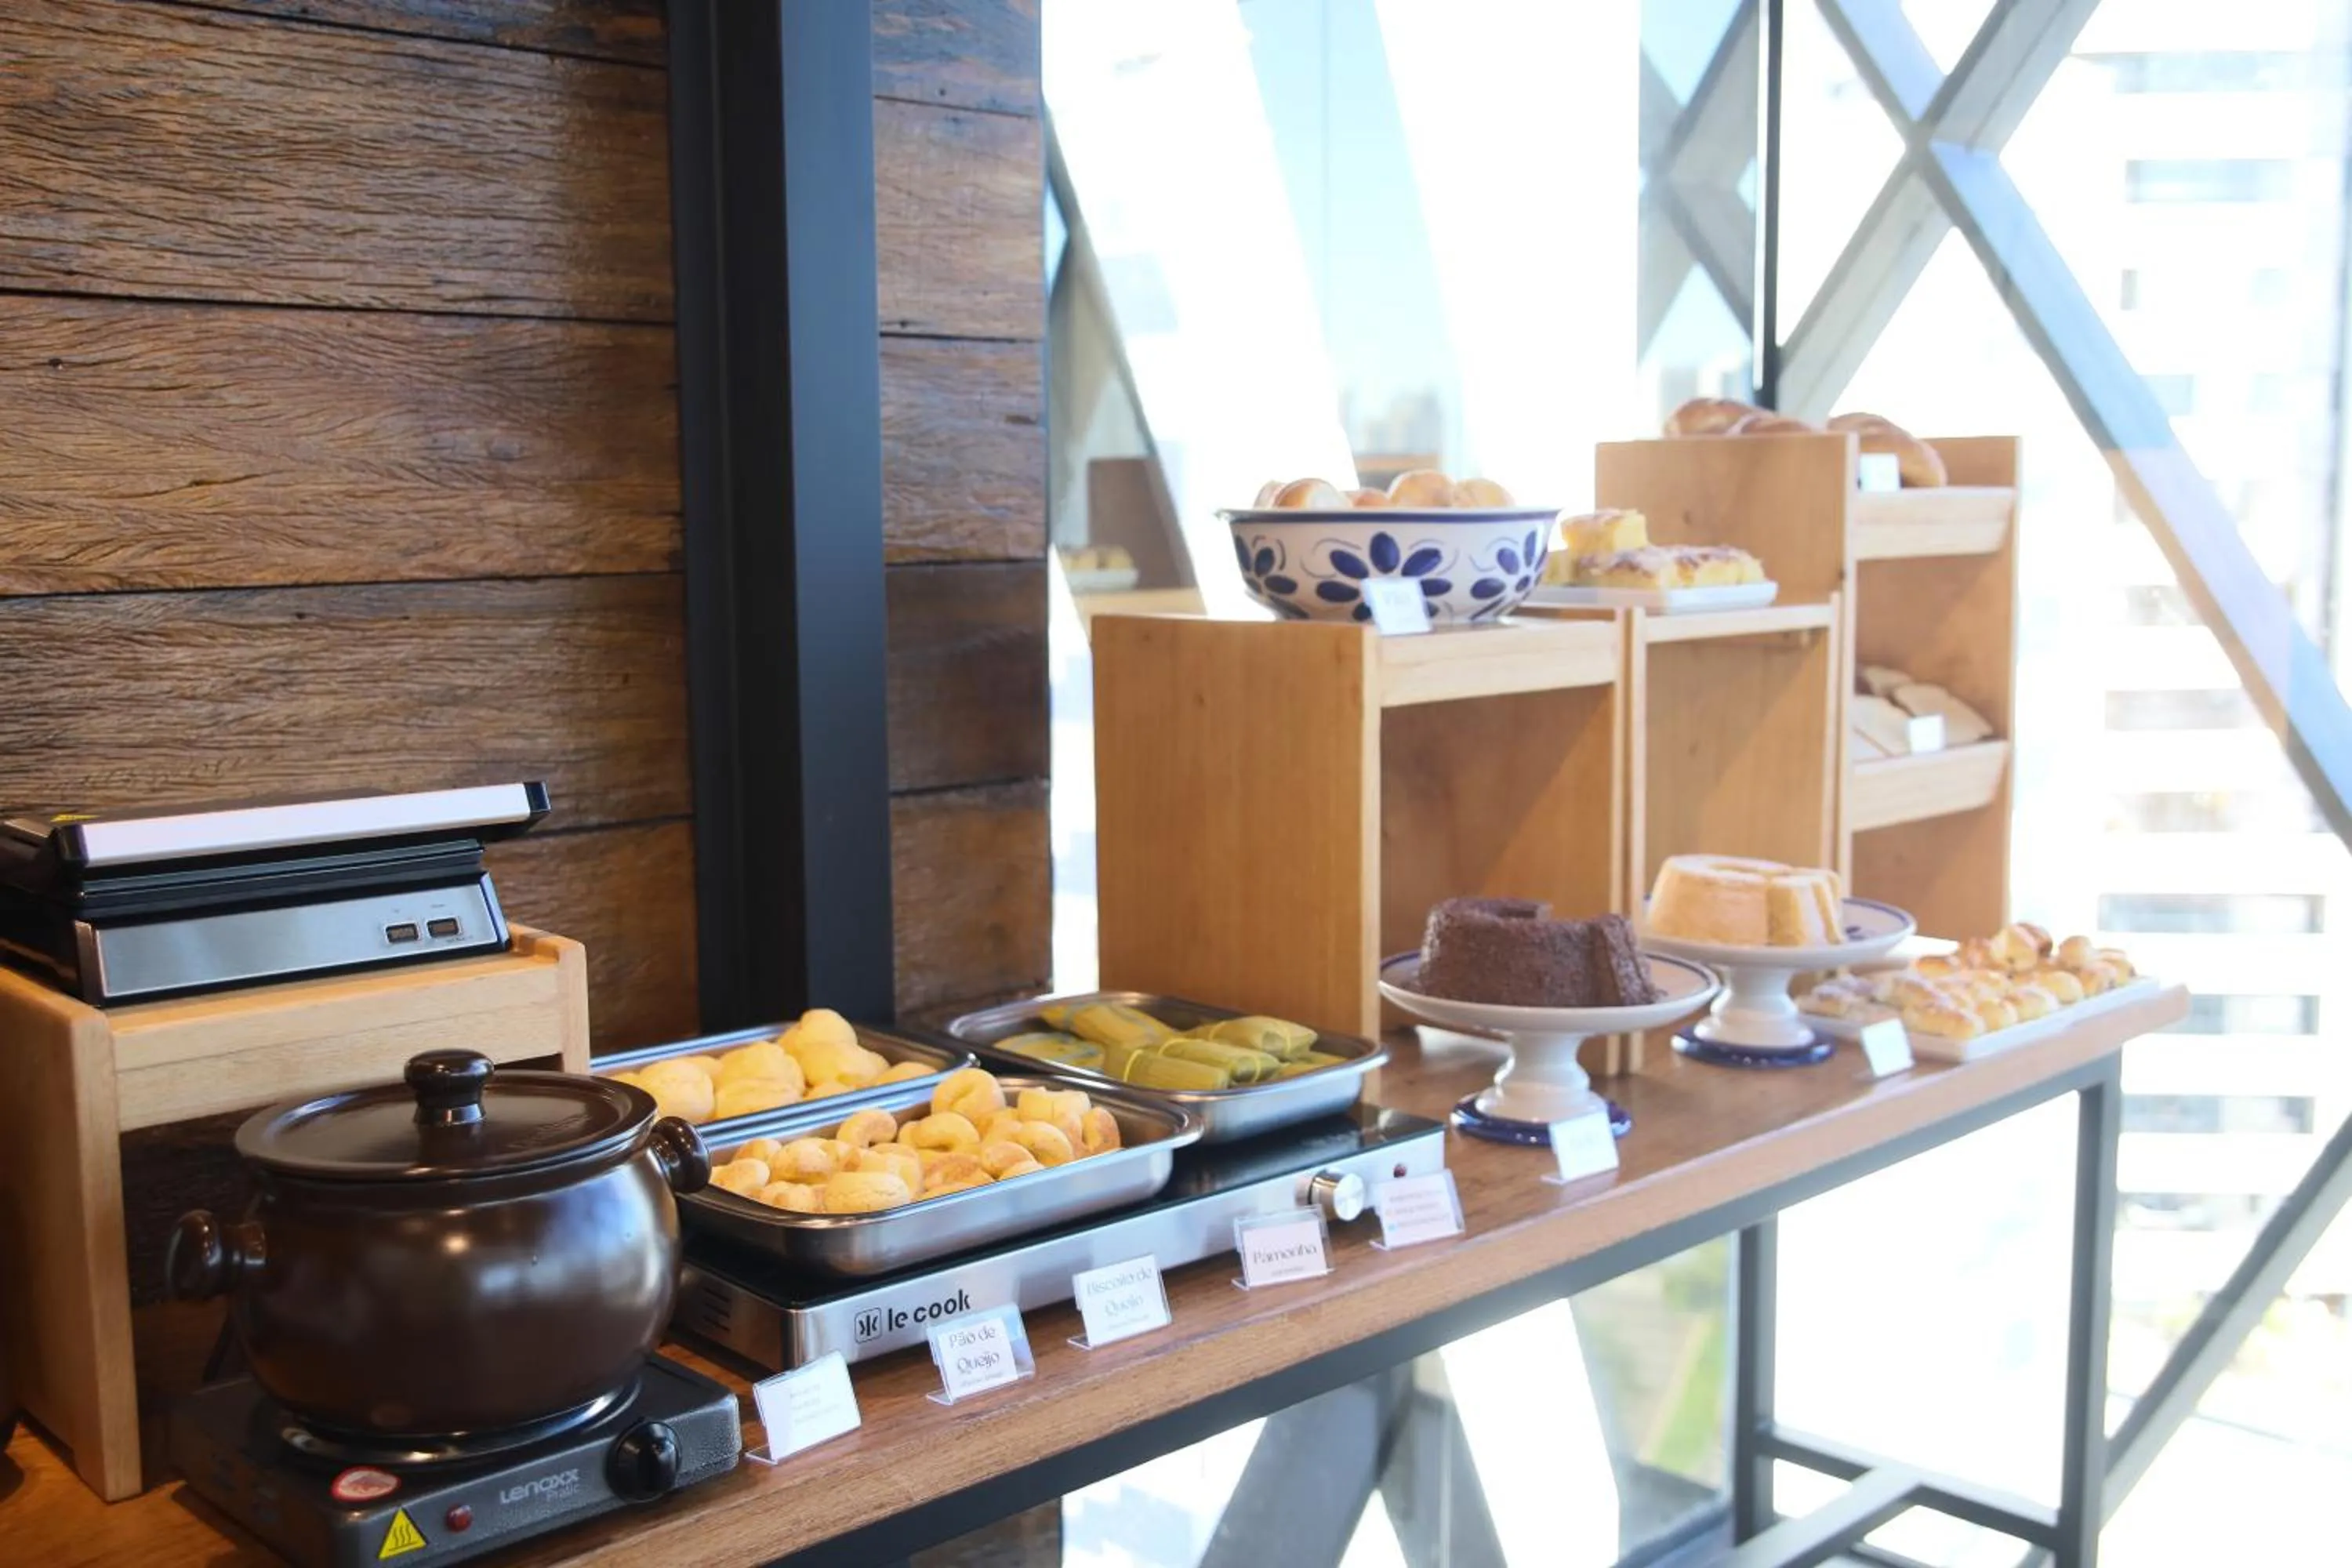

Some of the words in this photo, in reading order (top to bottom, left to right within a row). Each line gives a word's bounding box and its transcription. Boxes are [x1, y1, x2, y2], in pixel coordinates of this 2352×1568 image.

[1253, 1243, 1318, 1265] Pamonha
[1136, 1267, 1152, 1281] de
[887, 1308, 909, 1332] le
[913, 1289, 971, 1323] cook
[949, 1330, 976, 1349] Pão
[978, 1325, 996, 1341] de
[956, 1350, 1000, 1374] Queijo
